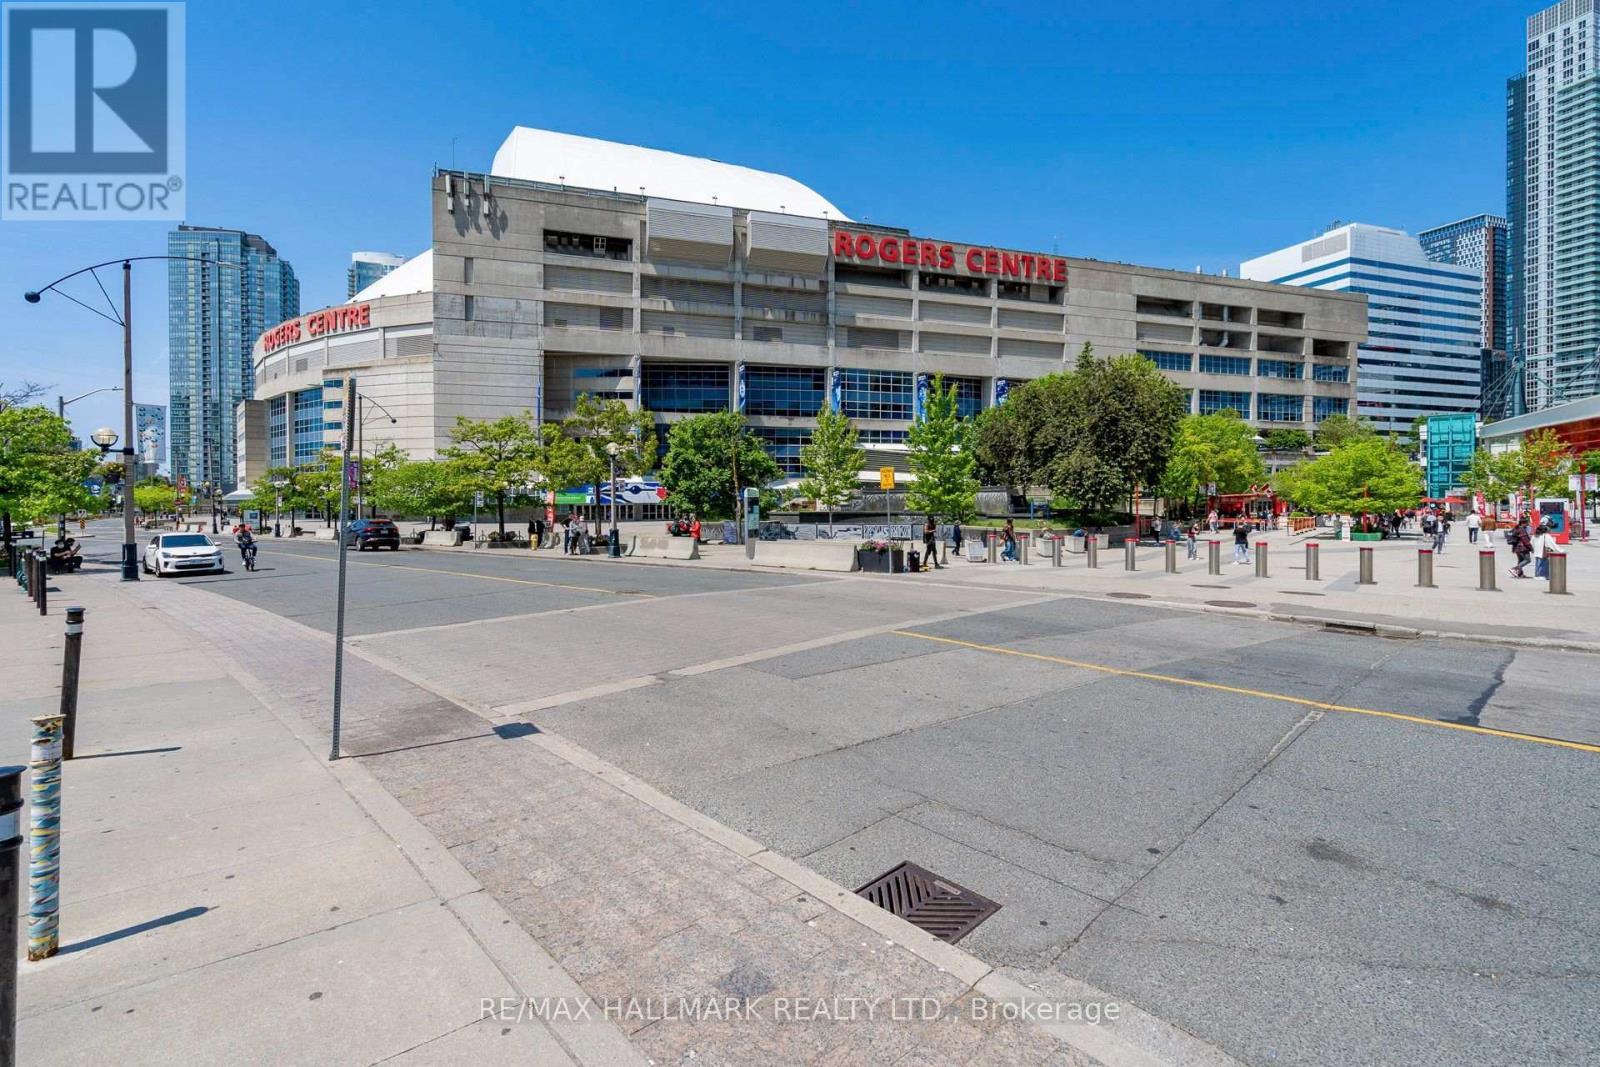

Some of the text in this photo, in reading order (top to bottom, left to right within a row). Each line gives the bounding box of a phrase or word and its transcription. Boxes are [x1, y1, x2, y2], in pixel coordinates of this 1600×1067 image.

[833, 229, 1068, 282] ROGERS CENTRE
[307, 304, 371, 337] CENTRE
